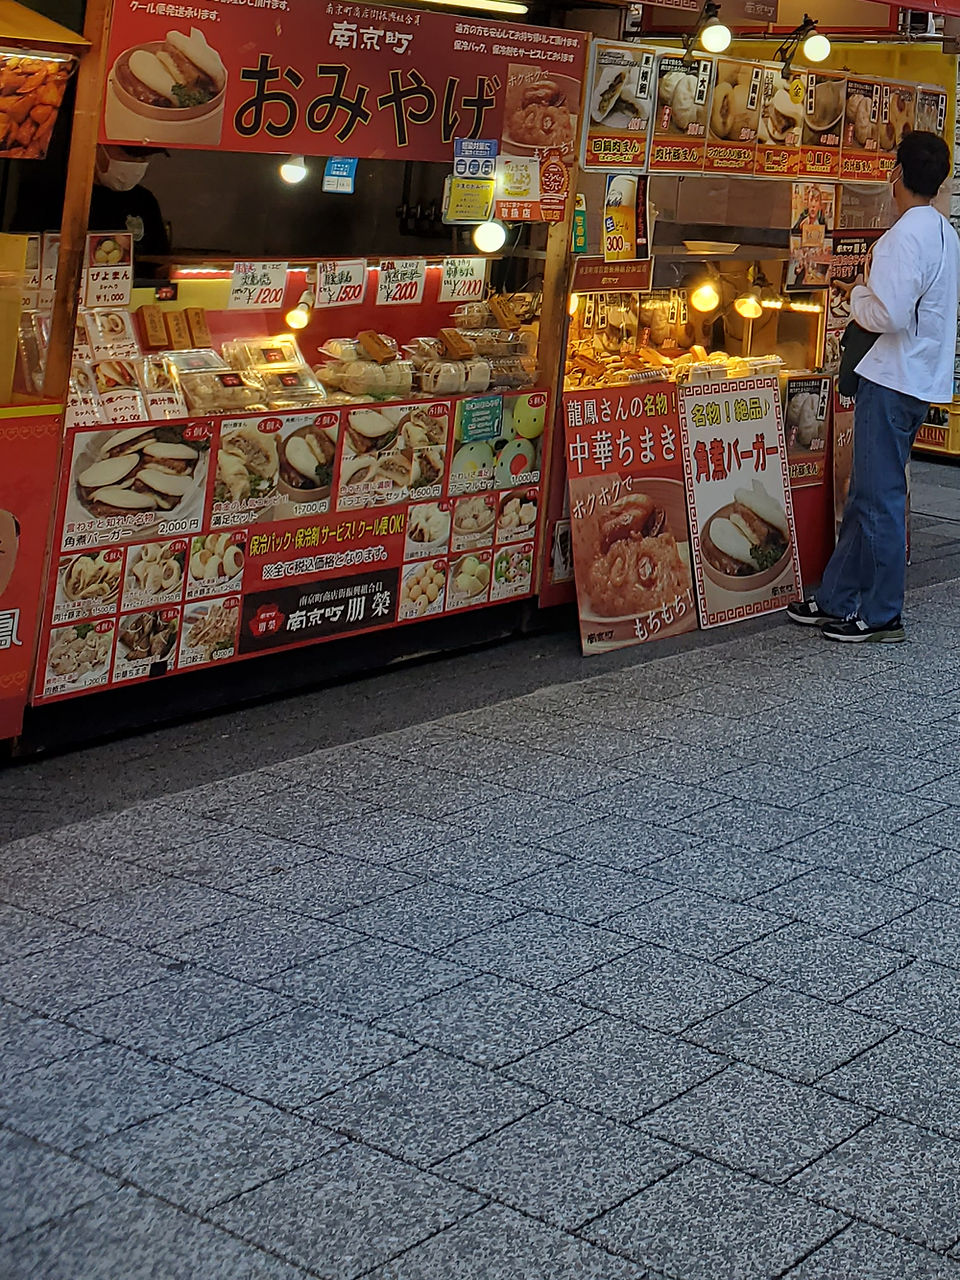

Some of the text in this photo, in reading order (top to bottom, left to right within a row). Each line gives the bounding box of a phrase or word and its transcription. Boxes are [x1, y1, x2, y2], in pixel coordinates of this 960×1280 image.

[328, 20, 414, 56] 南京町
[233, 53, 502, 146] おみやげ
[568, 424, 676, 474] 中華ちまき
[692, 432, 780, 485] 角煮バーガー
[572, 474, 634, 519] ホクホクで
[63, 528, 133, 549] 角煮バーガー
[286, 605, 345, 632] 南京町
[633, 588, 695, 642] もちもち!
